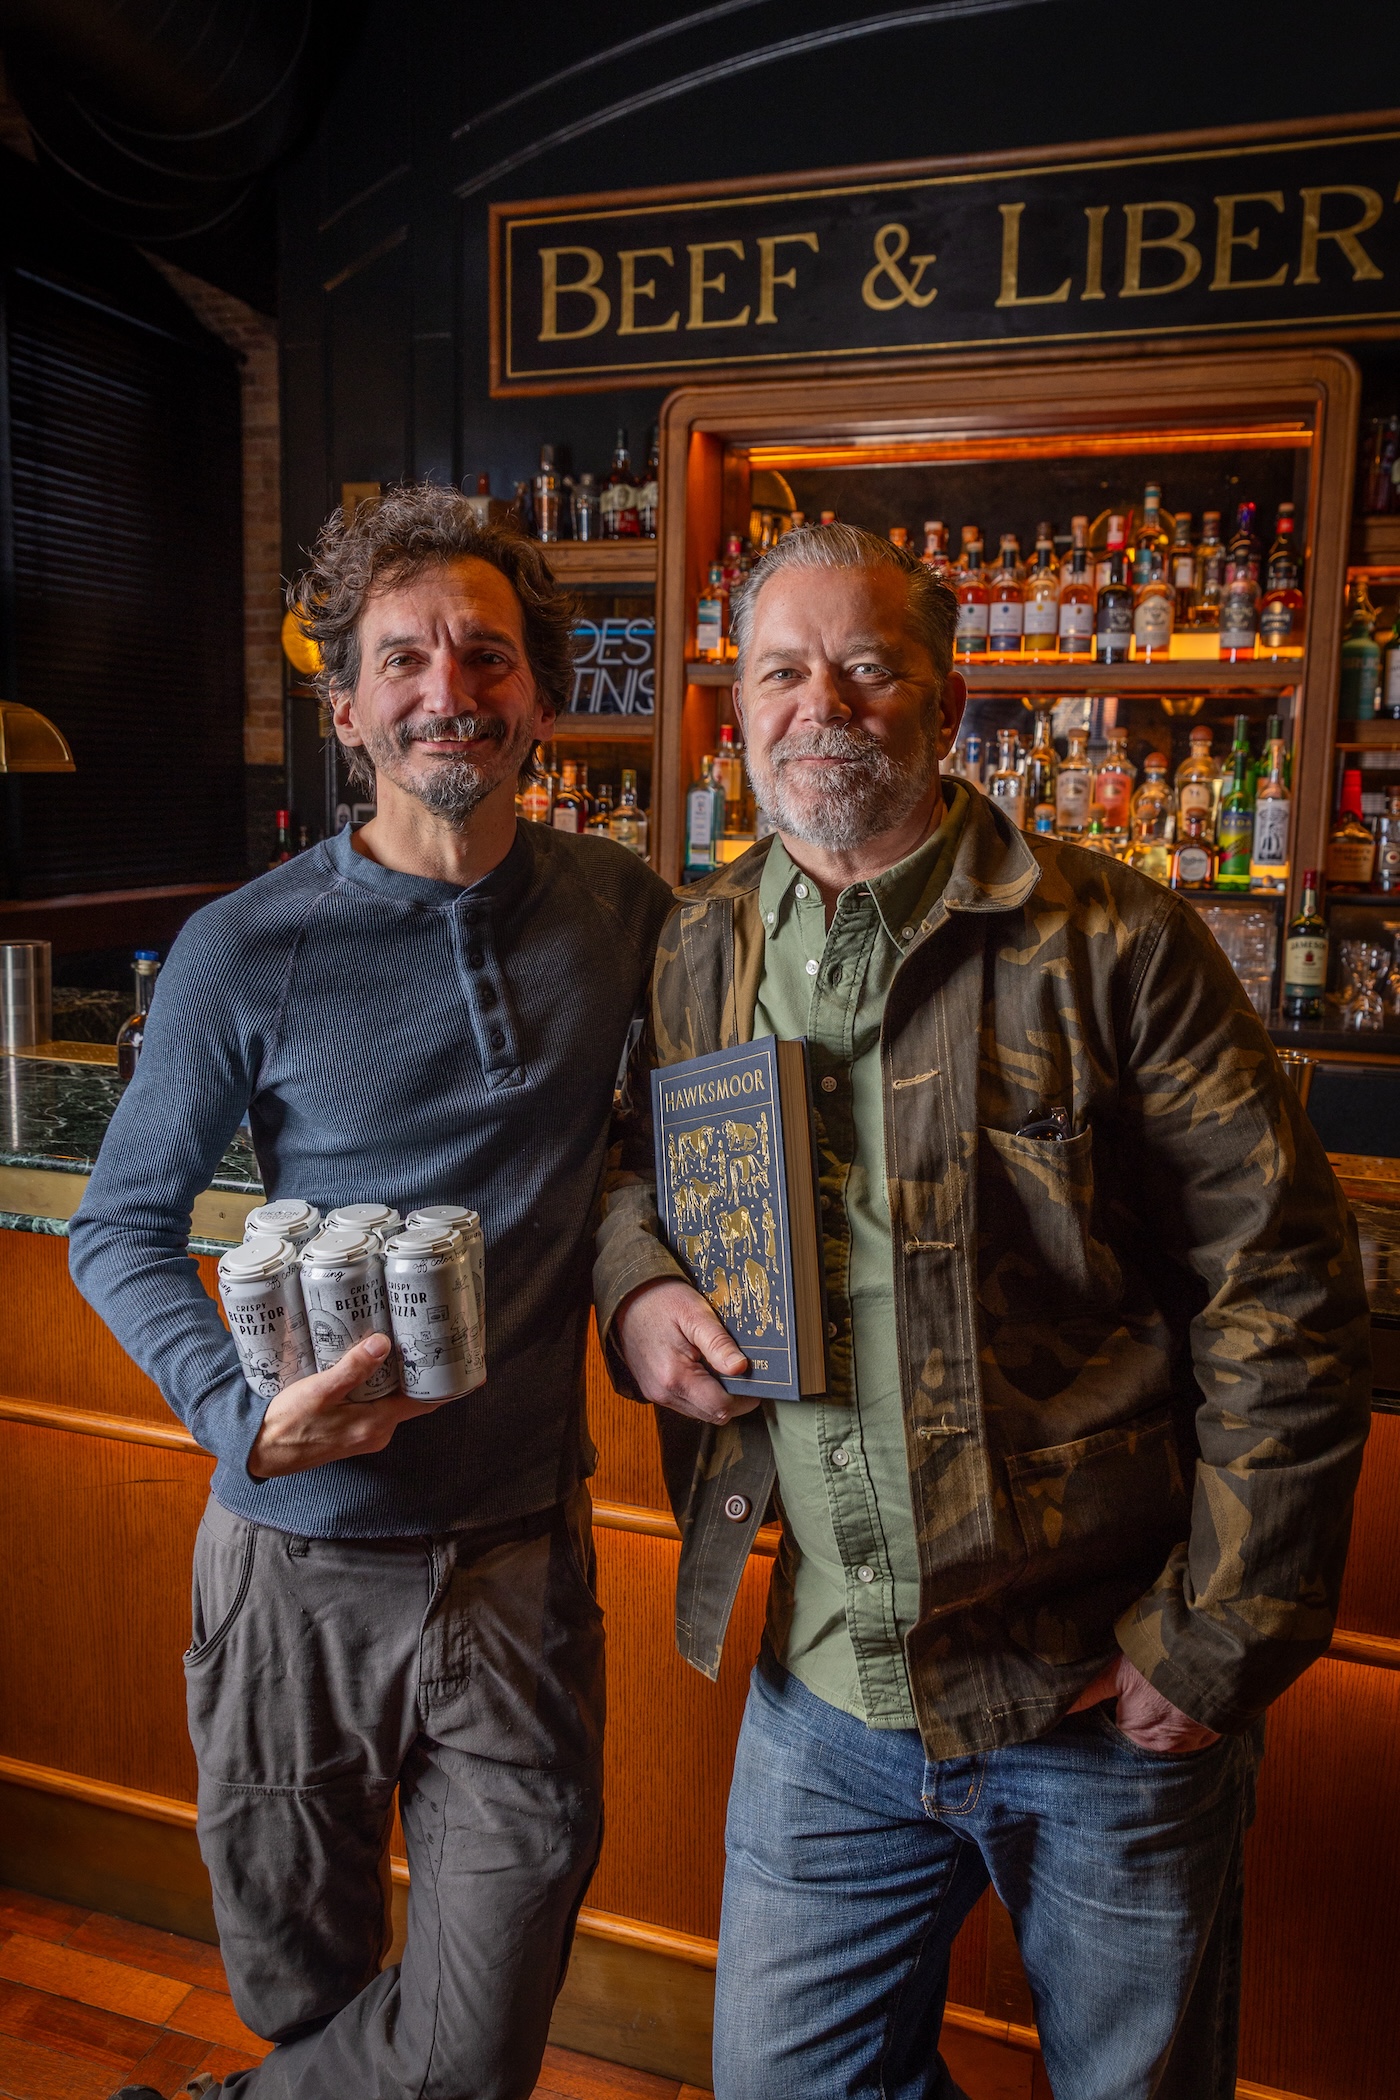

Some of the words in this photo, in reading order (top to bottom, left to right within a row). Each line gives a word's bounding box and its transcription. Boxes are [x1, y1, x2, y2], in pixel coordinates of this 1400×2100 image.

[537, 231, 820, 342] BEEF
[861, 222, 939, 312] &
[995, 180, 1400, 308] LIBER
[665, 1069, 766, 1113] HAWKSMOOR
[350, 1279, 379, 1295] CRISPY
[335, 1294, 369, 1311] BEER
[404, 1292, 427, 1304] FOR
[228, 1310, 255, 1324] BEER
[260, 1306, 285, 1322] FOR
[236, 1302, 267, 1313] CRISPY
[351, 1299, 386, 1322] PIZZA
[390, 1303, 417, 1318] PIZZA
[239, 1322, 276, 1336] PIZZA
